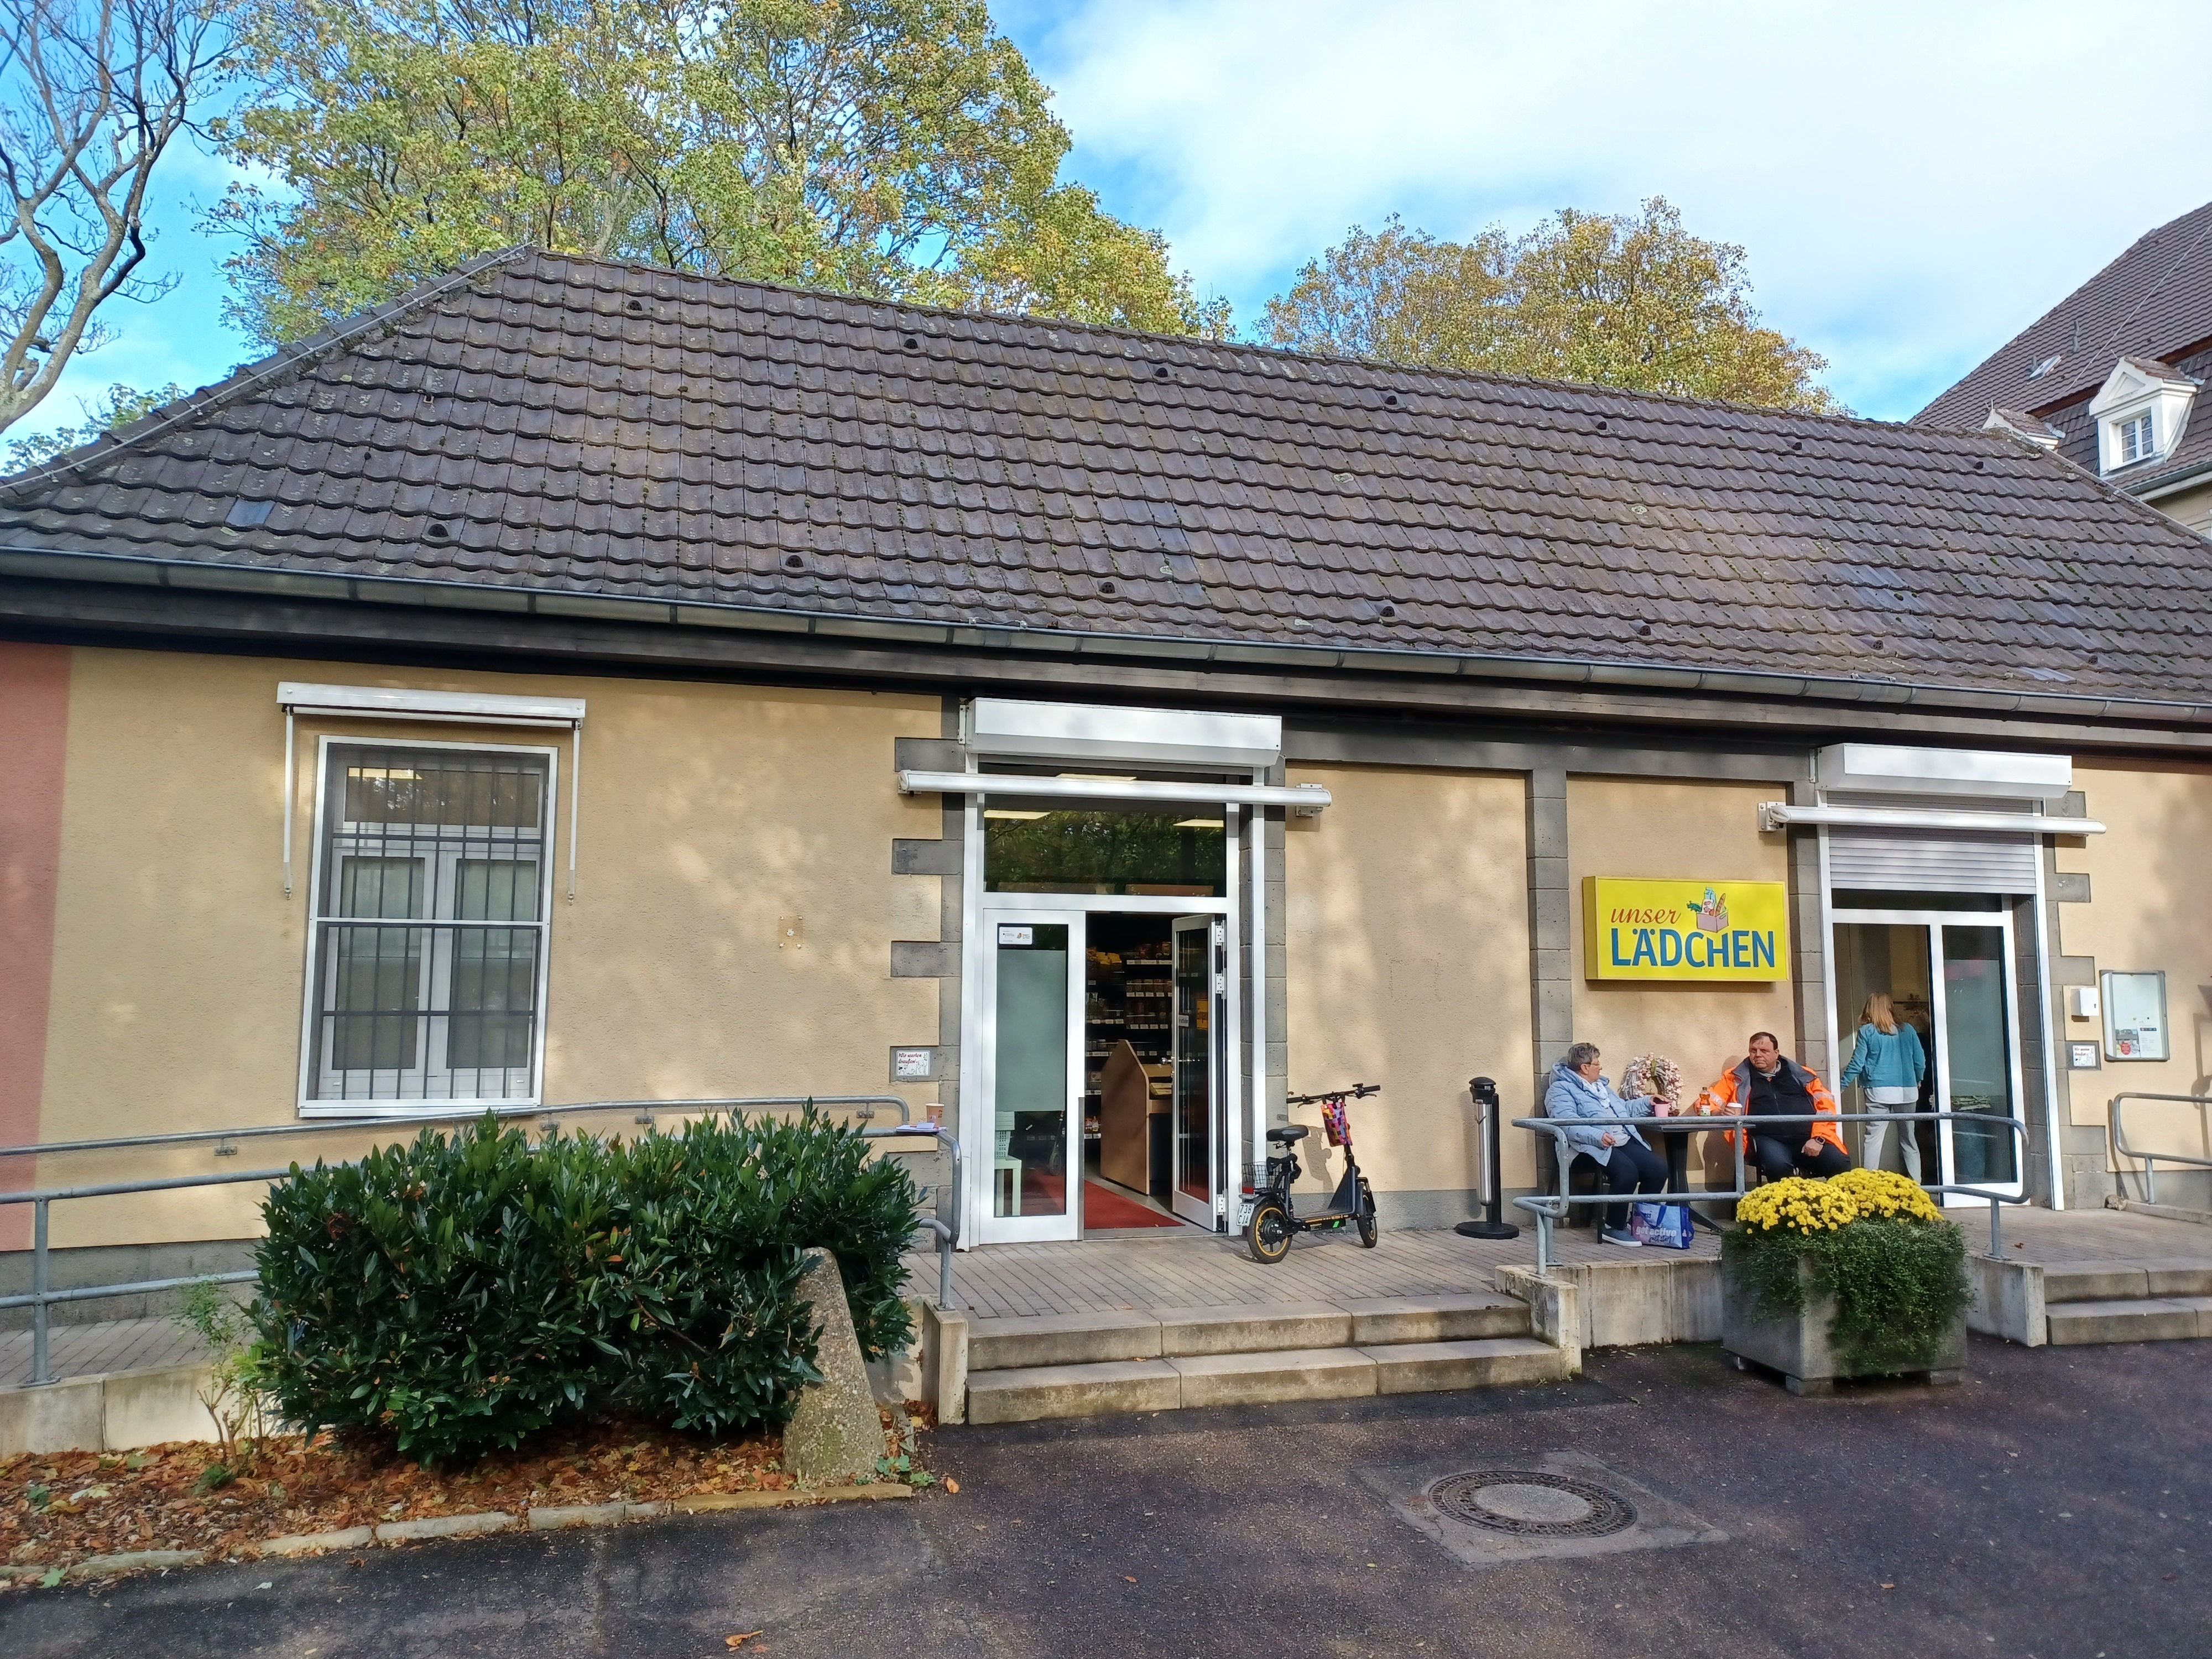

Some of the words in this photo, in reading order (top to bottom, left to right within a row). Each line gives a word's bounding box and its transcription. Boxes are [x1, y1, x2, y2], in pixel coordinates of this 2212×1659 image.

[1610, 907, 1681, 924] unser
[1611, 927, 1775, 968] LÄDCHEN
[1240, 1204, 1252, 1213] 738
[1636, 1226, 1648, 1235] get
[1649, 1228, 1677, 1237] active
